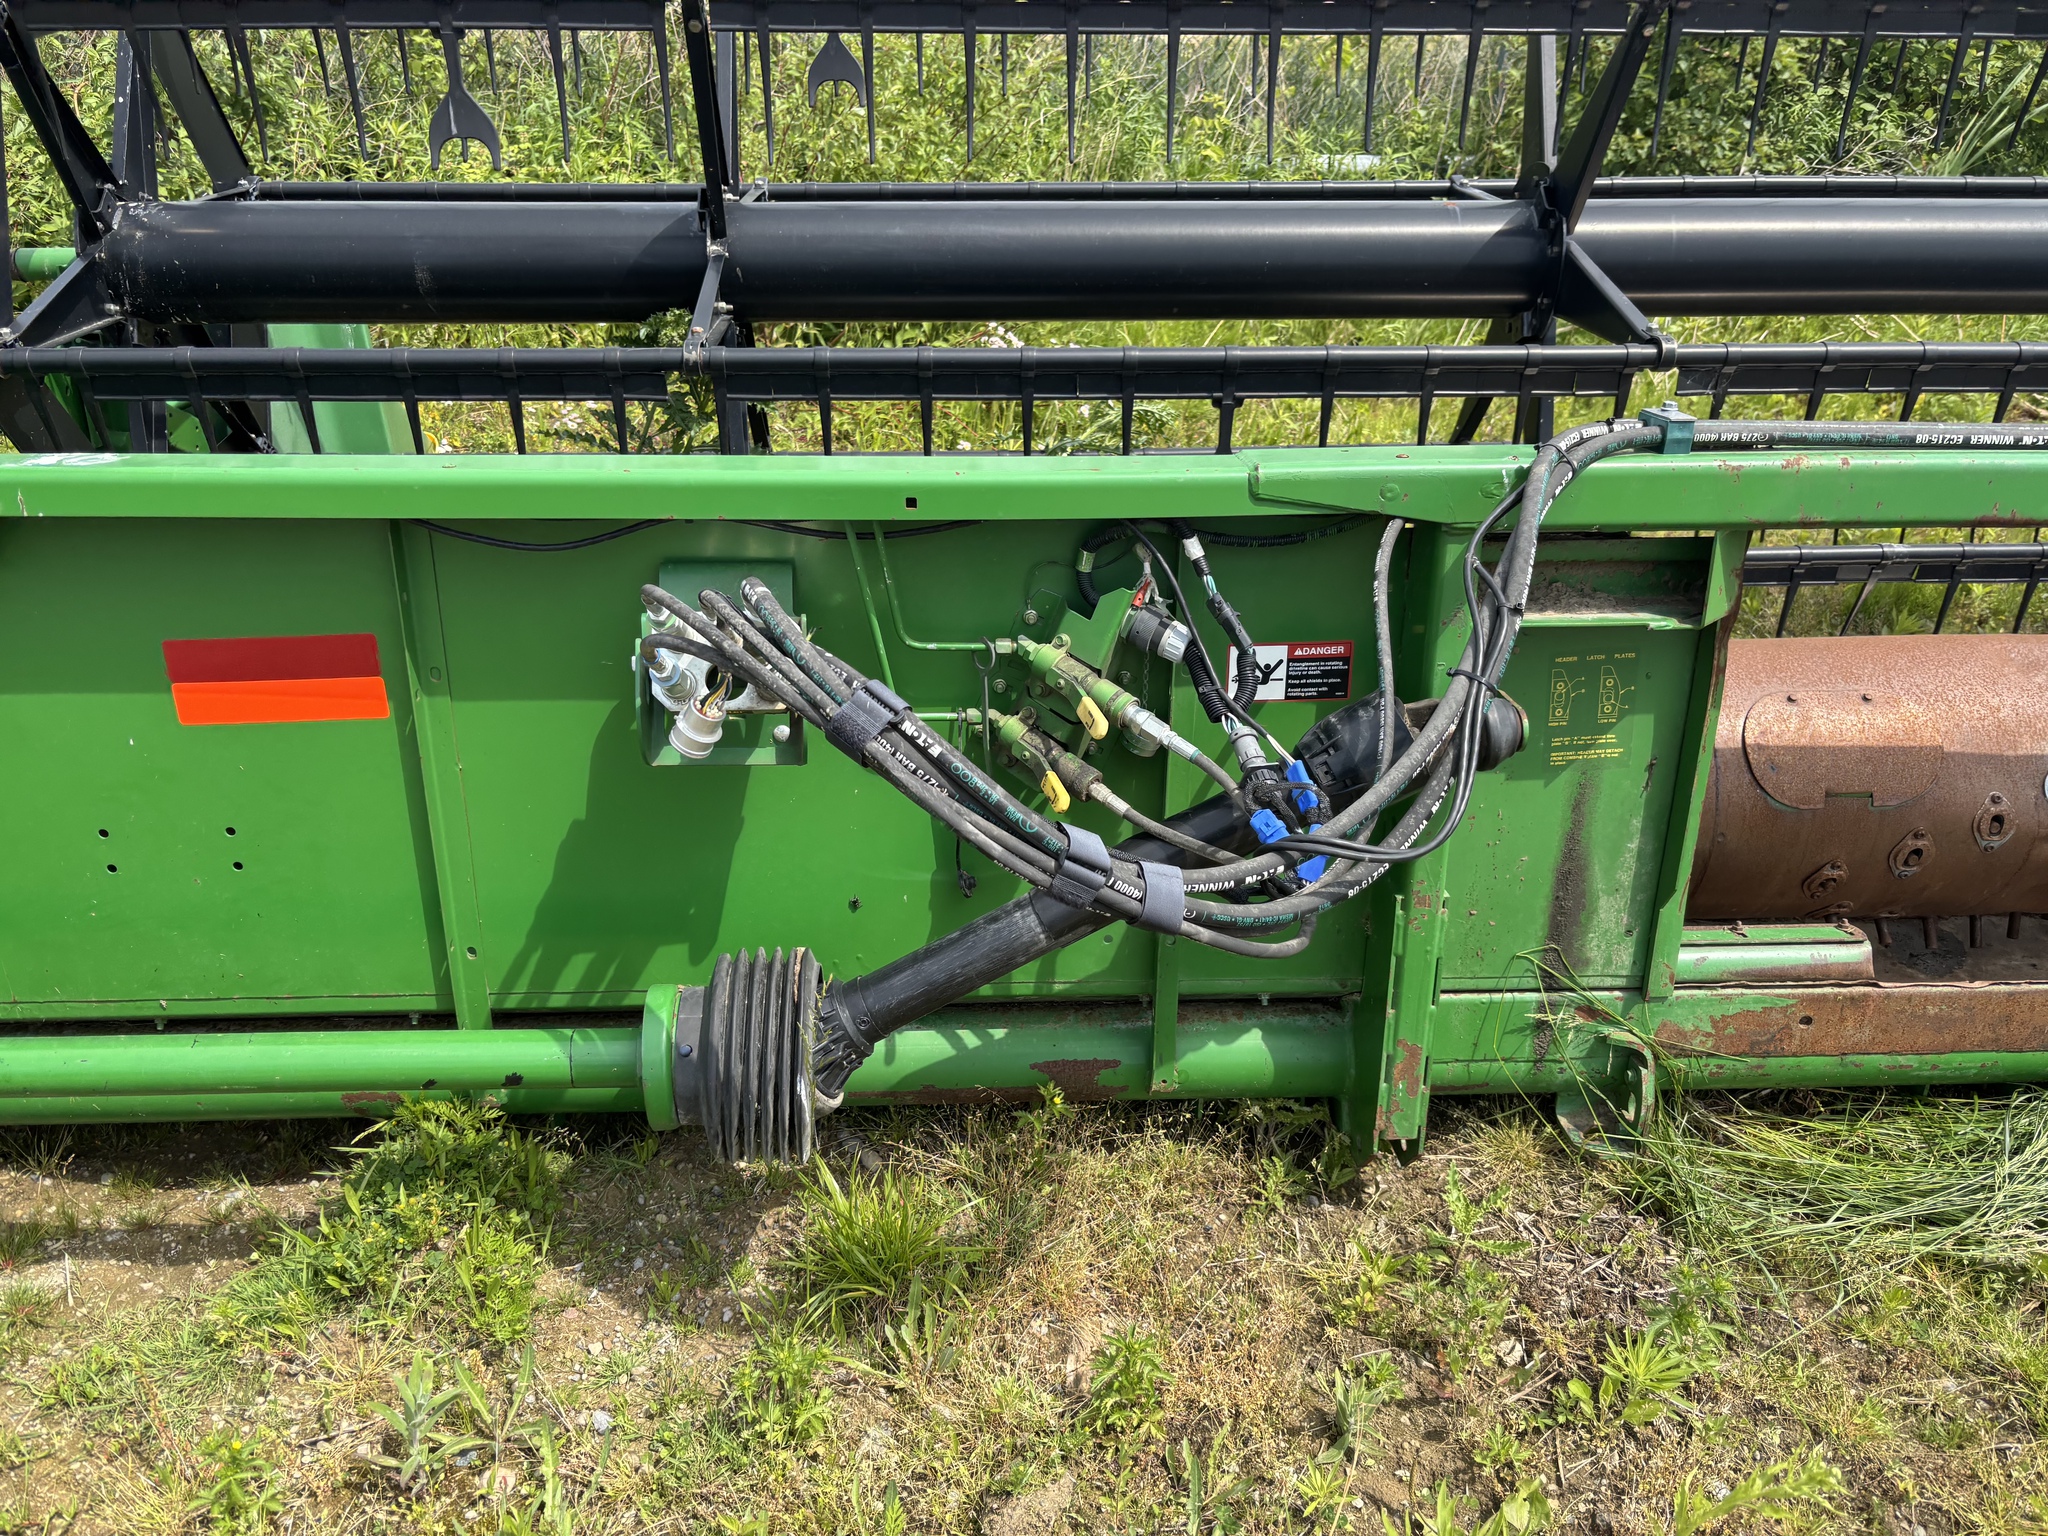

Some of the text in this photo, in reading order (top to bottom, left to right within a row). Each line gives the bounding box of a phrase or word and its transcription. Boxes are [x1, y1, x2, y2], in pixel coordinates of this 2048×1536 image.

[1581, 425, 1609, 439] WINNER
[1720, 432, 1739, 442] BAR
[1740, 432, 1758, 442] 275
[1915, 433, 1964, 445] EC215-08
[1970, 434, 2014, 445] WINNER
[1303, 646, 1344, 655] DANGER
[899, 720, 943, 759] EATON
[895, 751, 917, 774] BAR
[1244, 864, 1285, 886] EATON
[1113, 882, 1143, 900] (4000
